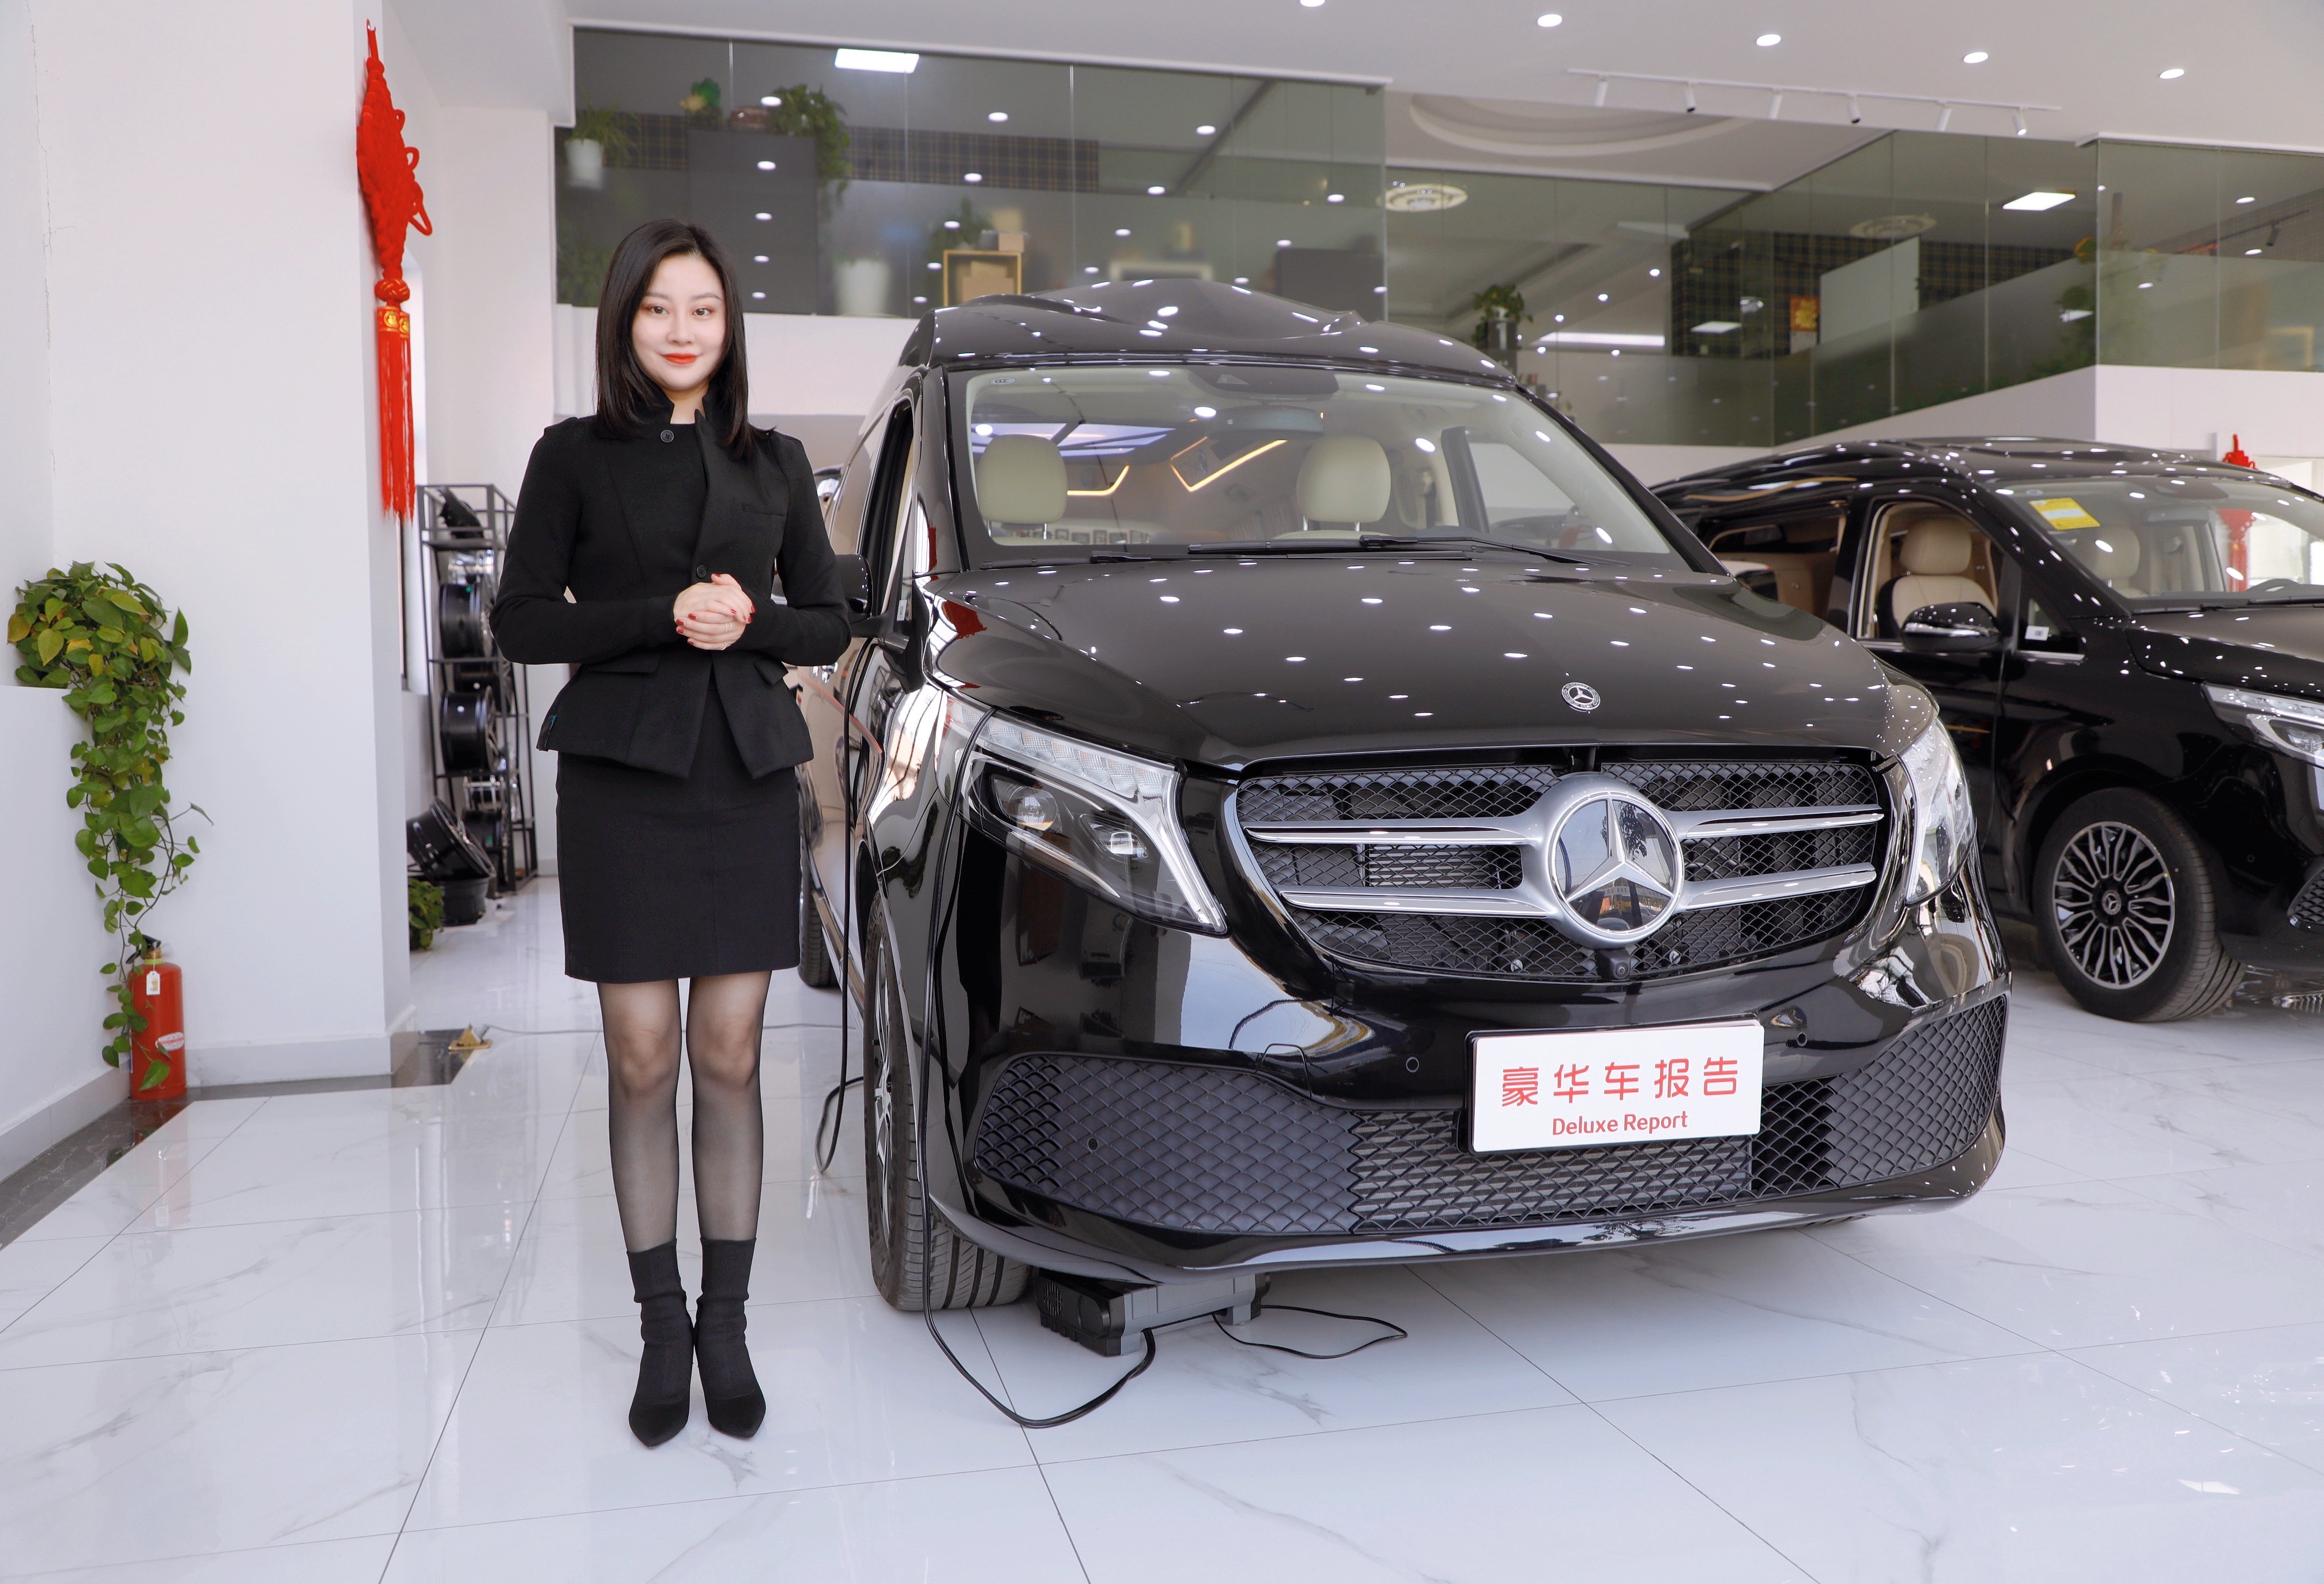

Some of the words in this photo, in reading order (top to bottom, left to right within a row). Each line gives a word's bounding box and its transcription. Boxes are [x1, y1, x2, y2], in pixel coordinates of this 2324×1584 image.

[1502, 1057, 1738, 1107] 豪华车报告
[1552, 1116, 1618, 1136] Deluxe
[1624, 1111, 1688, 1134] Report
